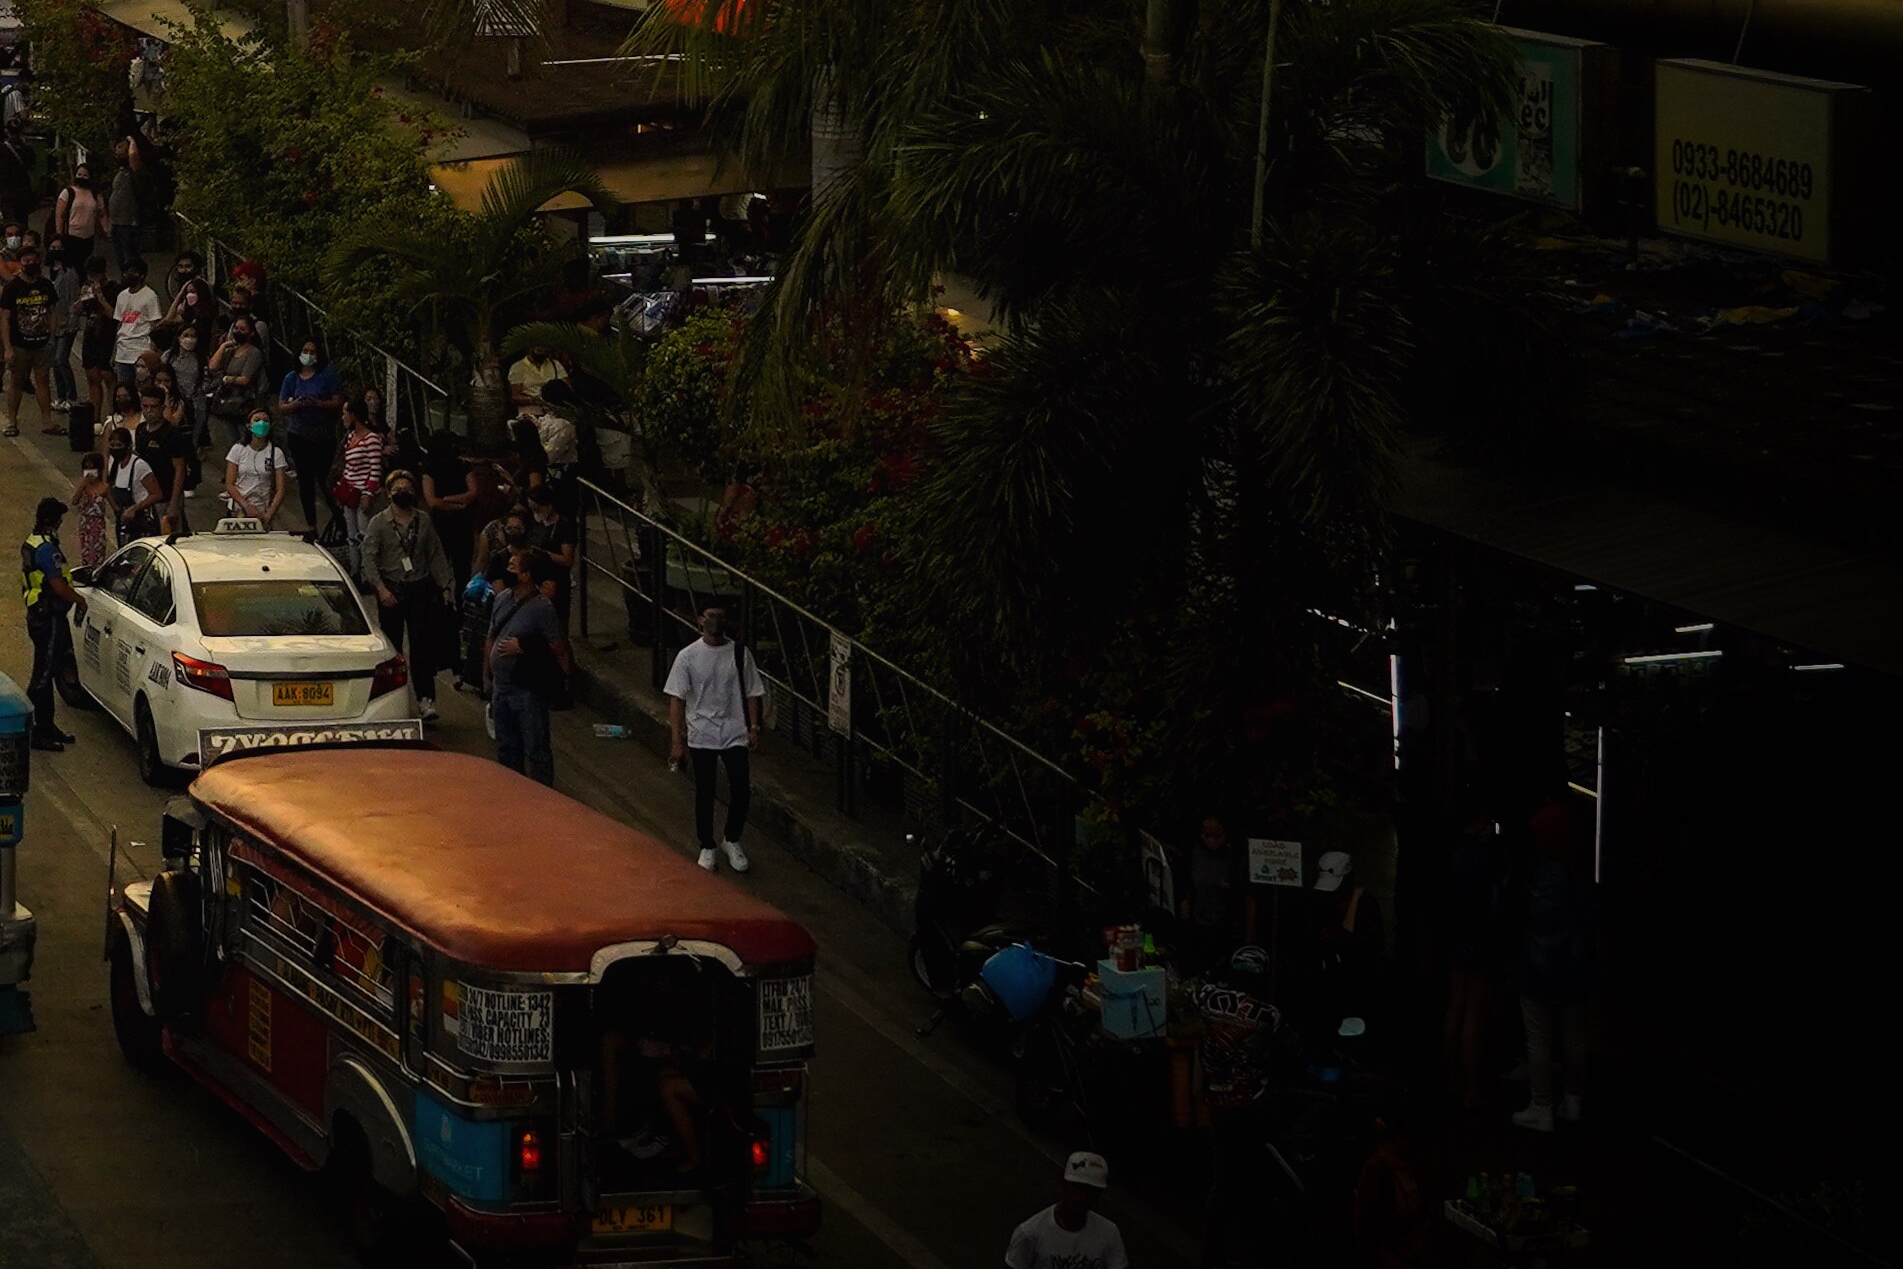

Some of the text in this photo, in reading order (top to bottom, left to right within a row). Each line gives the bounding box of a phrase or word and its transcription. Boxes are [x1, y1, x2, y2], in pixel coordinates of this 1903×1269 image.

[1672, 137, 1814, 202] 0933-8684689
[1672, 182, 1803, 242] (02)-8465320
[223, 521, 258, 532] TAXI
[637, 1206, 665, 1223] 361
